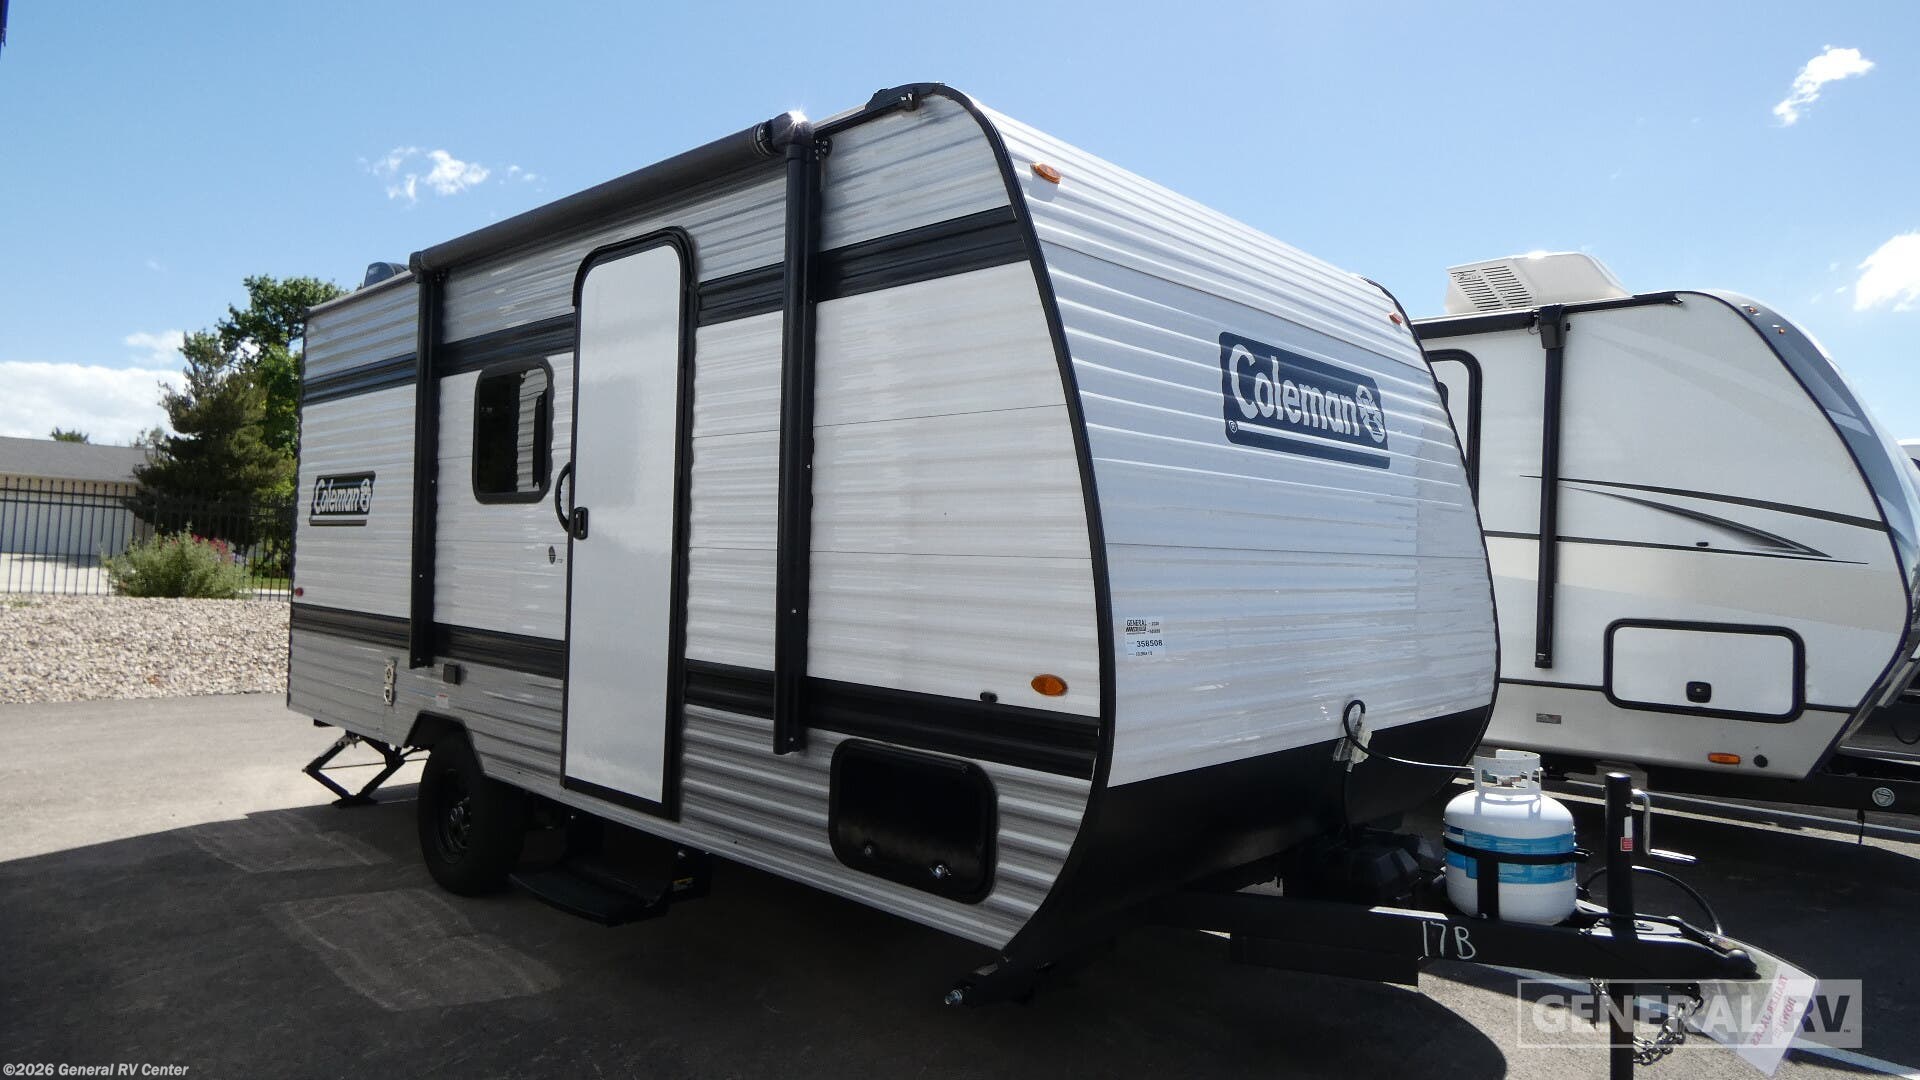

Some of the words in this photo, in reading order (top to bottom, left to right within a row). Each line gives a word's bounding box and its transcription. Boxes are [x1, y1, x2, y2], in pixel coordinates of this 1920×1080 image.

[1229, 344, 1360, 436] Coleman
[313, 479, 360, 514] Coleman
[1422, 921, 1477, 960] 17B
